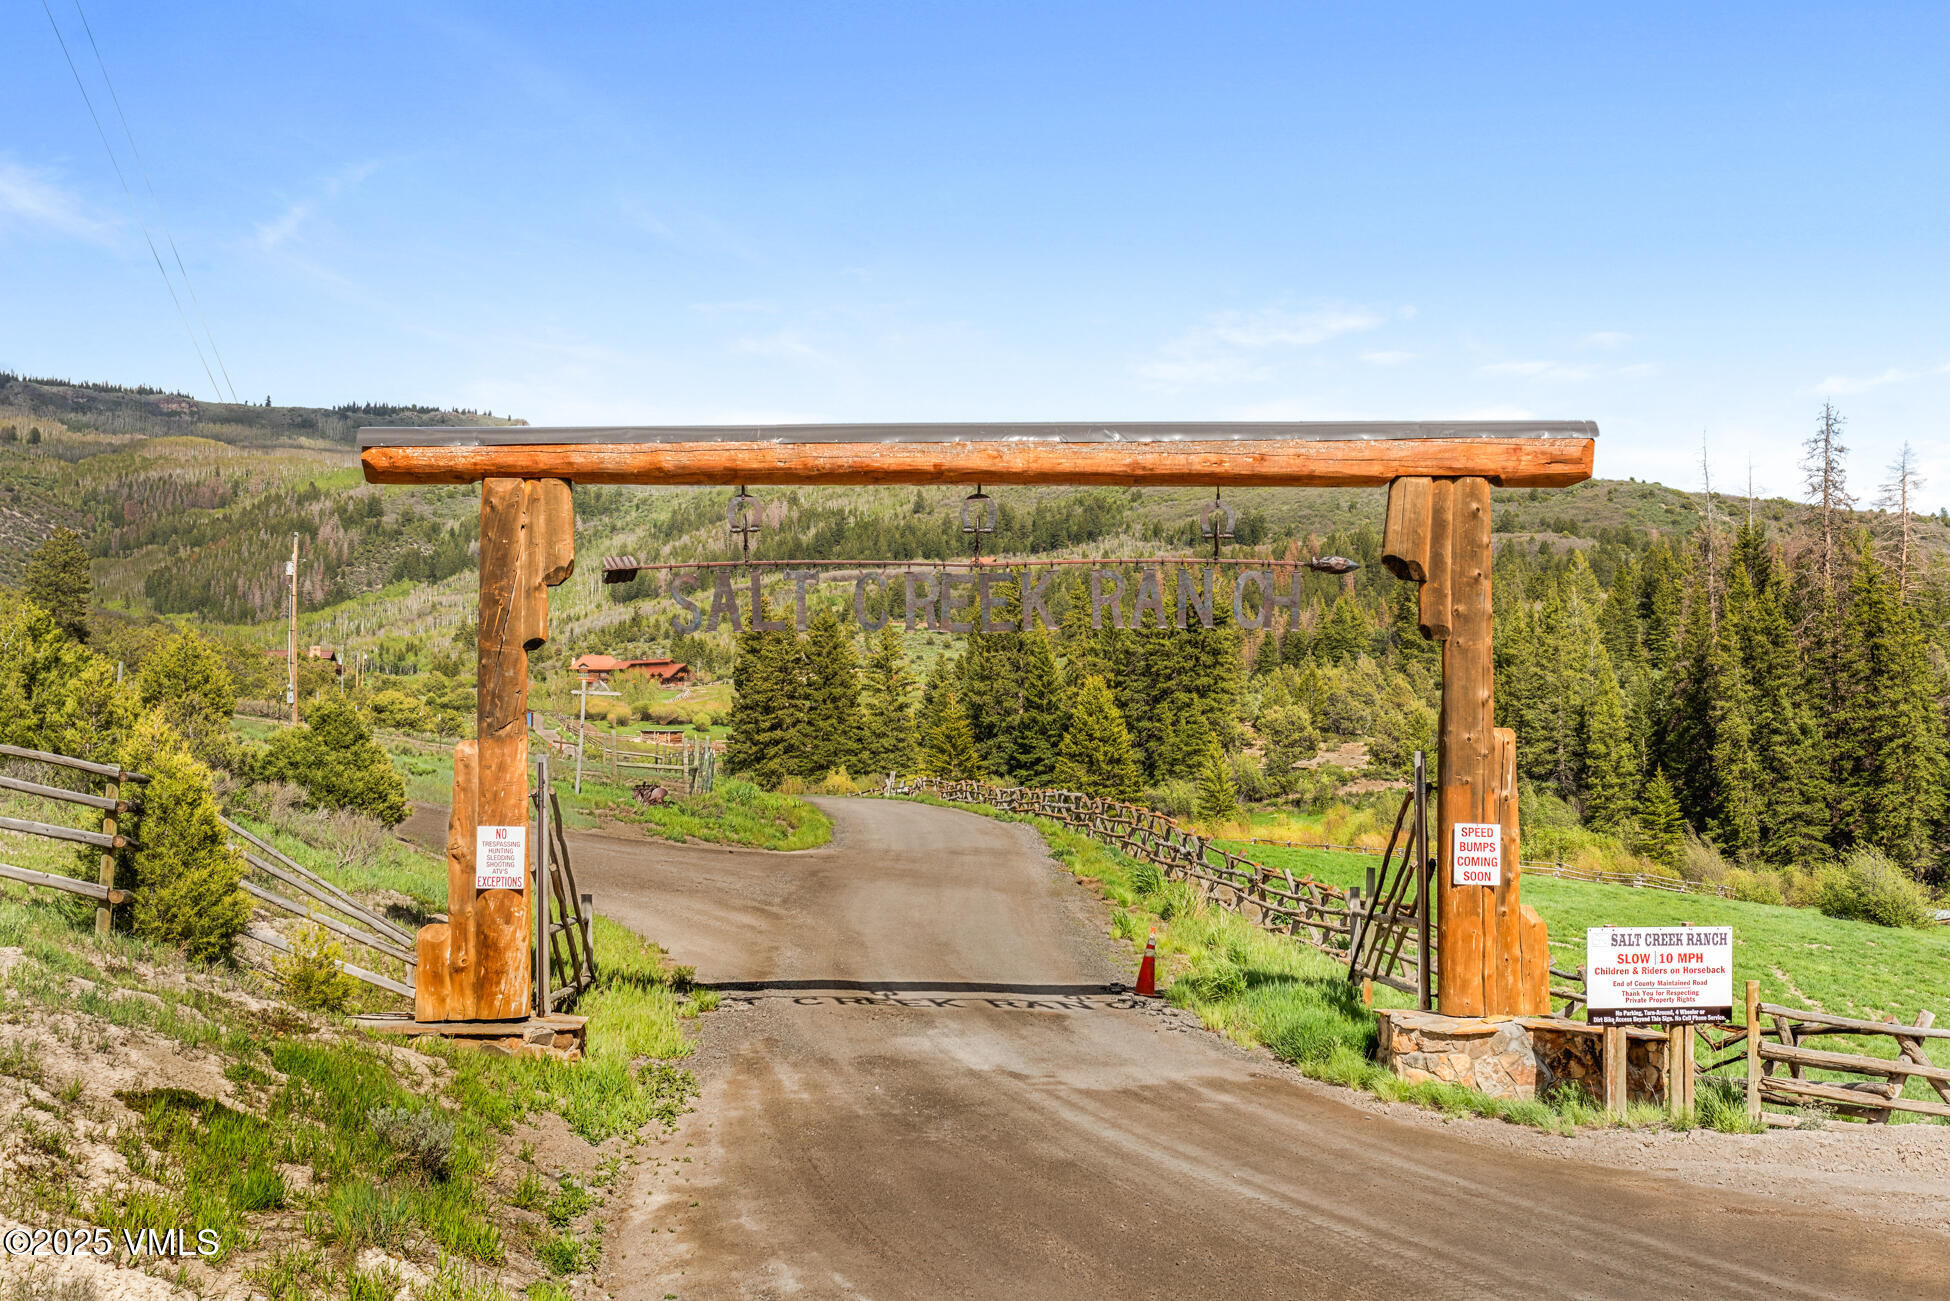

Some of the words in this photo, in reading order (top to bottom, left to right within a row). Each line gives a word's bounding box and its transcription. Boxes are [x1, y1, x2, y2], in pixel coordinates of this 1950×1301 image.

[671, 570, 819, 634] SALT
[854, 570, 1059, 633] CREEK
[1091, 568, 1303, 632] RANCH
[495, 829, 507, 839] NO
[1461, 826, 1494, 838] SPEED
[1459, 842, 1496, 852] BUMPS
[1457, 856, 1498, 867] COMING
[477, 876, 522, 888] EXCEPTIONS
[1463, 871, 1491, 882] SOON
[1611, 933, 1642, 947] SALT
[1644, 932, 1683, 947] CREEK
[1686, 932, 1728, 946] RANCH
[1617, 953, 1651, 964] SLOW
[1659, 953, 1673, 964] 10
[1677, 952, 1704, 964] MPH
[1594, 966, 1630, 975] Children
[1632, 966, 1639, 975] &
[1641, 966, 1668, 975] Riders
[1682, 965, 1726, 974] Horseback
[1634, 980, 1655, 988] County
[1648, 996, 1675, 1004] Property
